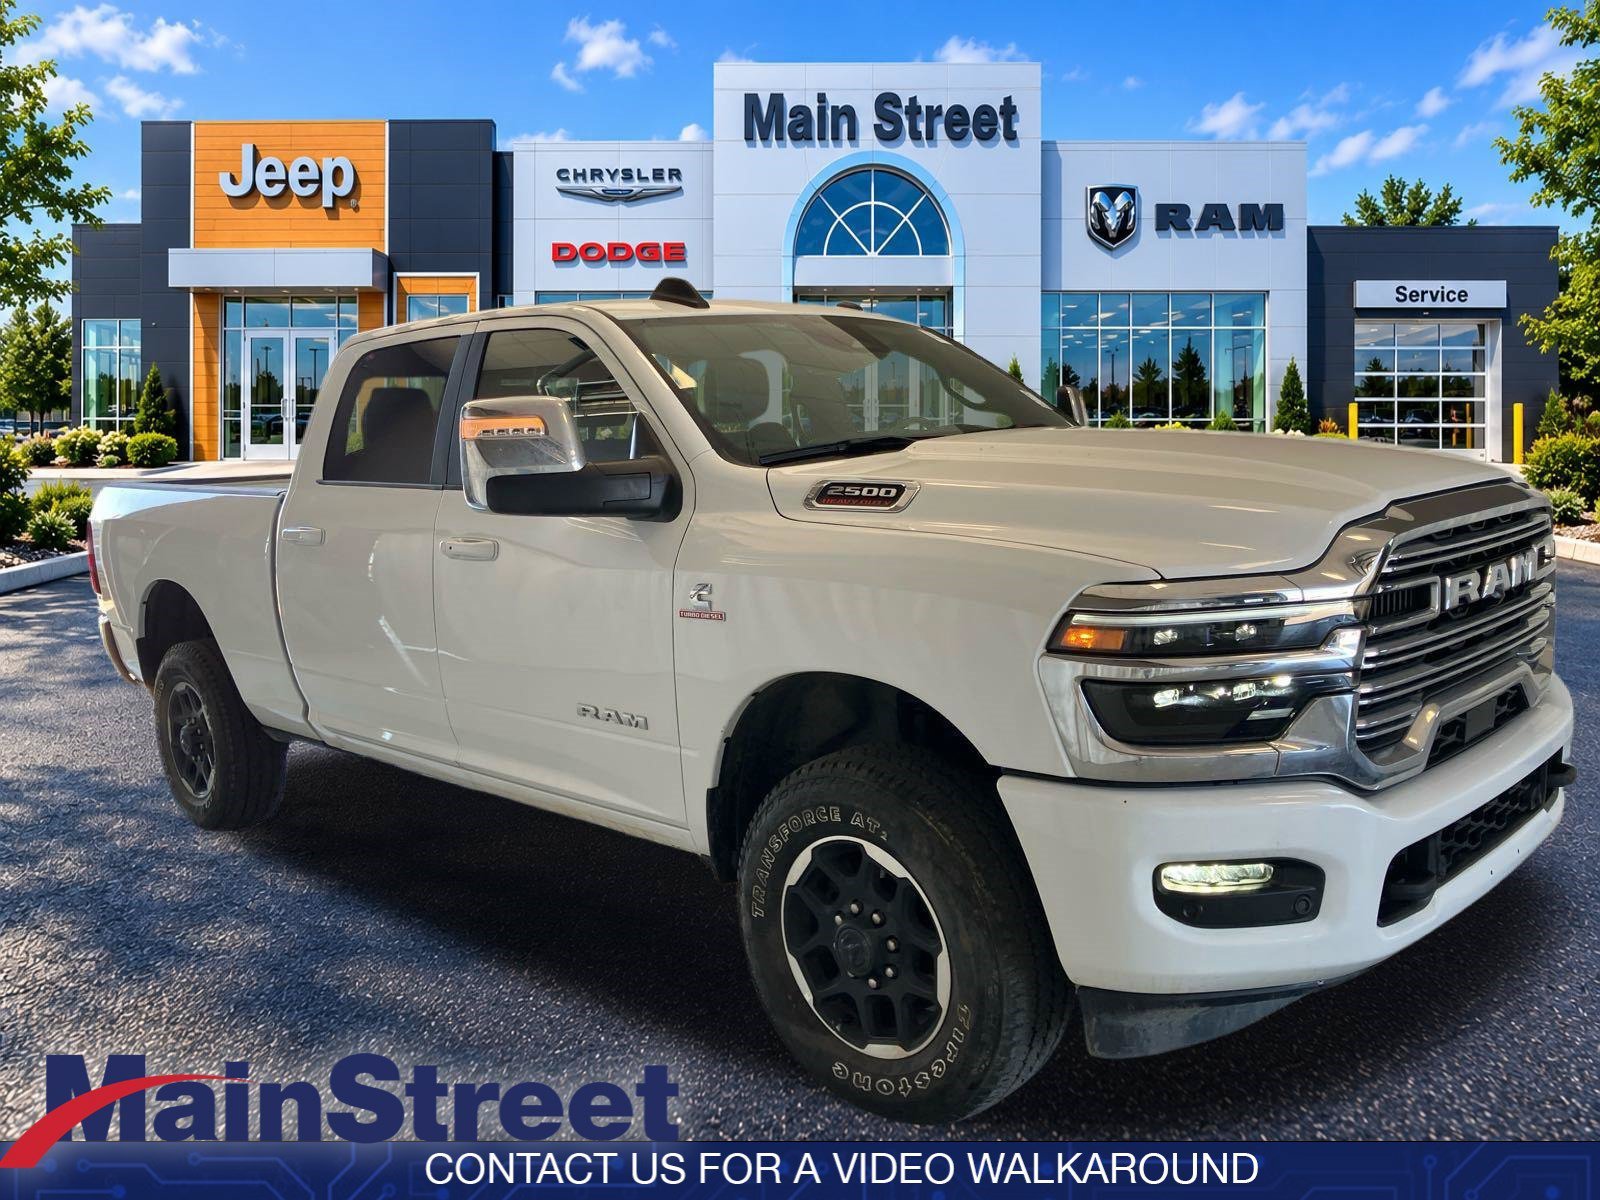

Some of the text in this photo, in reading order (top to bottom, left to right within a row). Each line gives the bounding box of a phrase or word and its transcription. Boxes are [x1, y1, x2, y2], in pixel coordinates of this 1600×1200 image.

[744, 92, 1018, 142] Main Street
[218, 143, 356, 209] Jeep
[556, 168, 683, 183] CHRYSLER
[1155, 203, 1285, 232] RAM
[551, 242, 686, 262] DODGE
[1395, 285, 1469, 303] Service
[826, 485, 898, 498] 2500
[1444, 544, 1539, 610] RAM
[679, 611, 723, 620] TURBO DIESEL
[576, 702, 649, 730] RAM
[751, 805, 842, 919] TRANSFORCE
